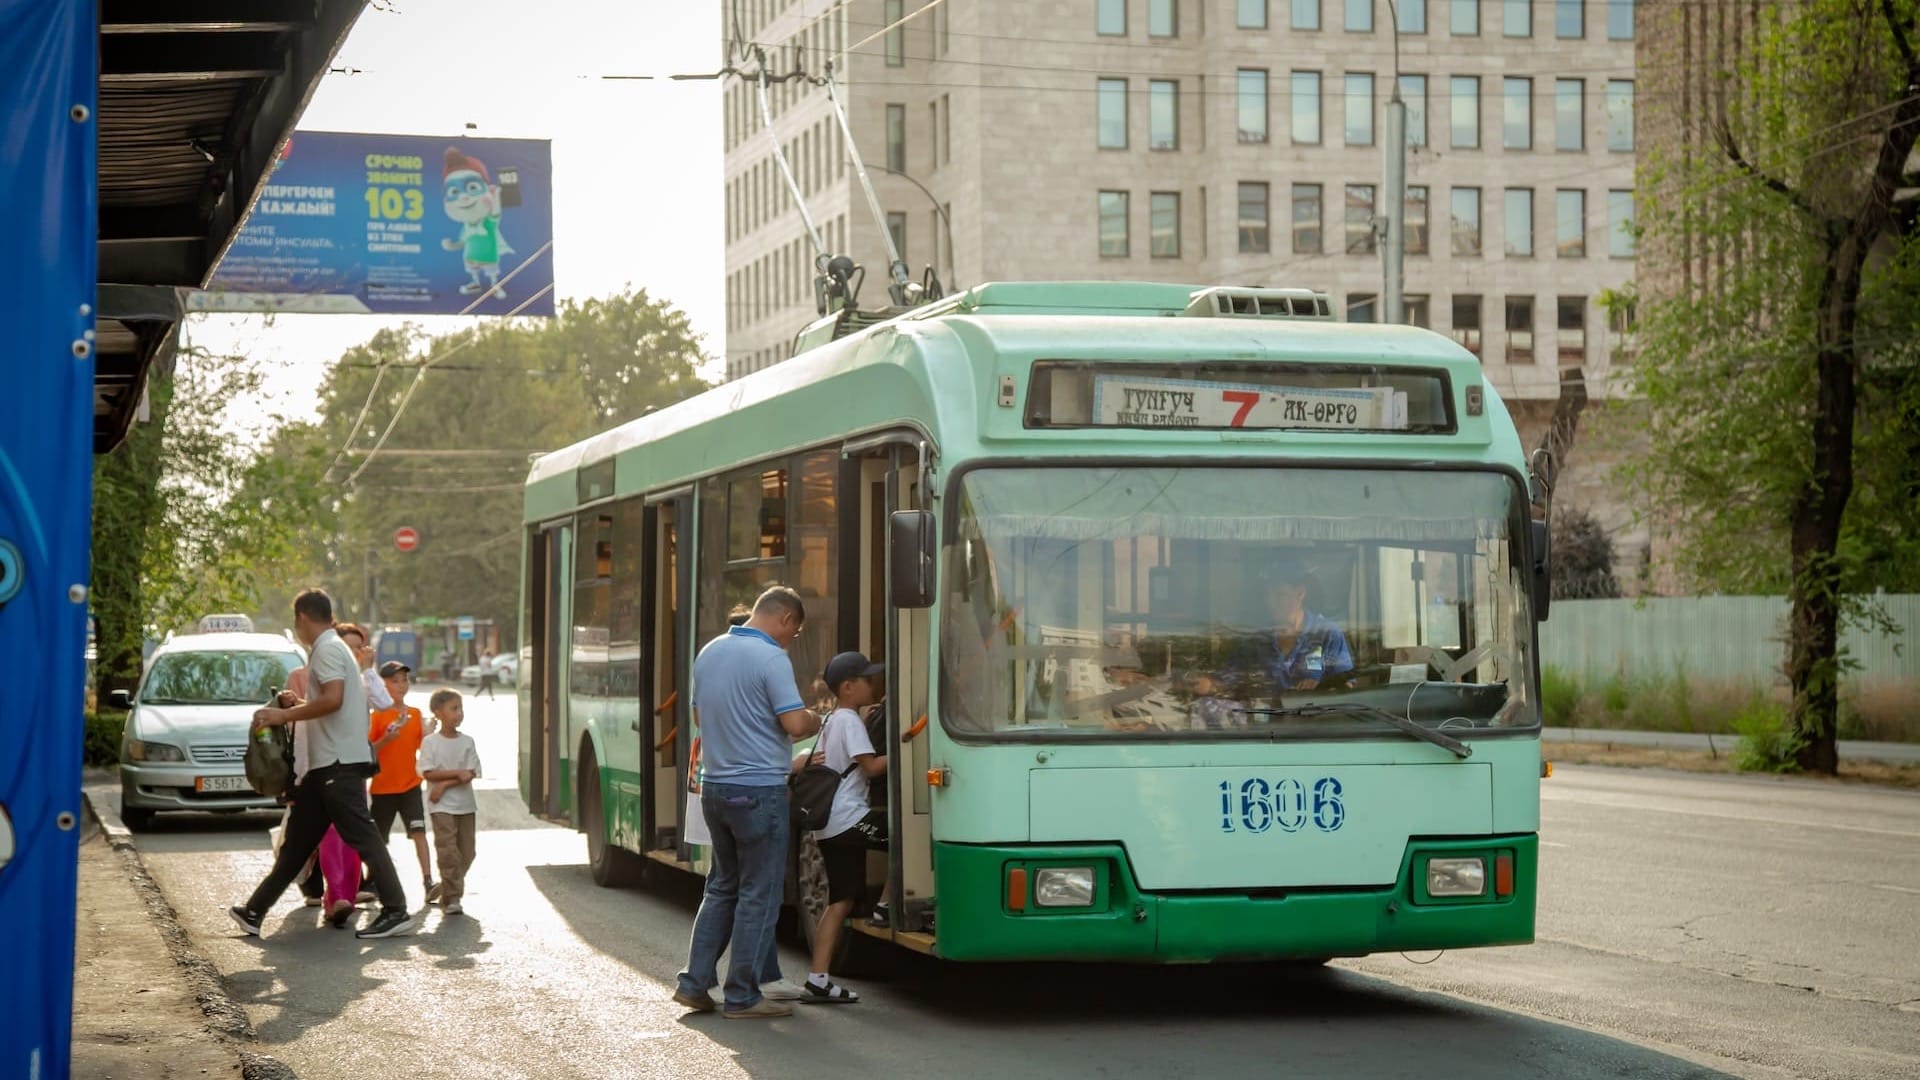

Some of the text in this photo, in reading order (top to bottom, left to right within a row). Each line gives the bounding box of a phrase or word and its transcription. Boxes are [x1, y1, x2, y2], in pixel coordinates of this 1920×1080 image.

[365, 154, 422, 169] СРОЧНО
[365, 187, 423, 220] 103
[1222, 390, 1260, 428] 7
[1219, 777, 1345, 833] 1606
